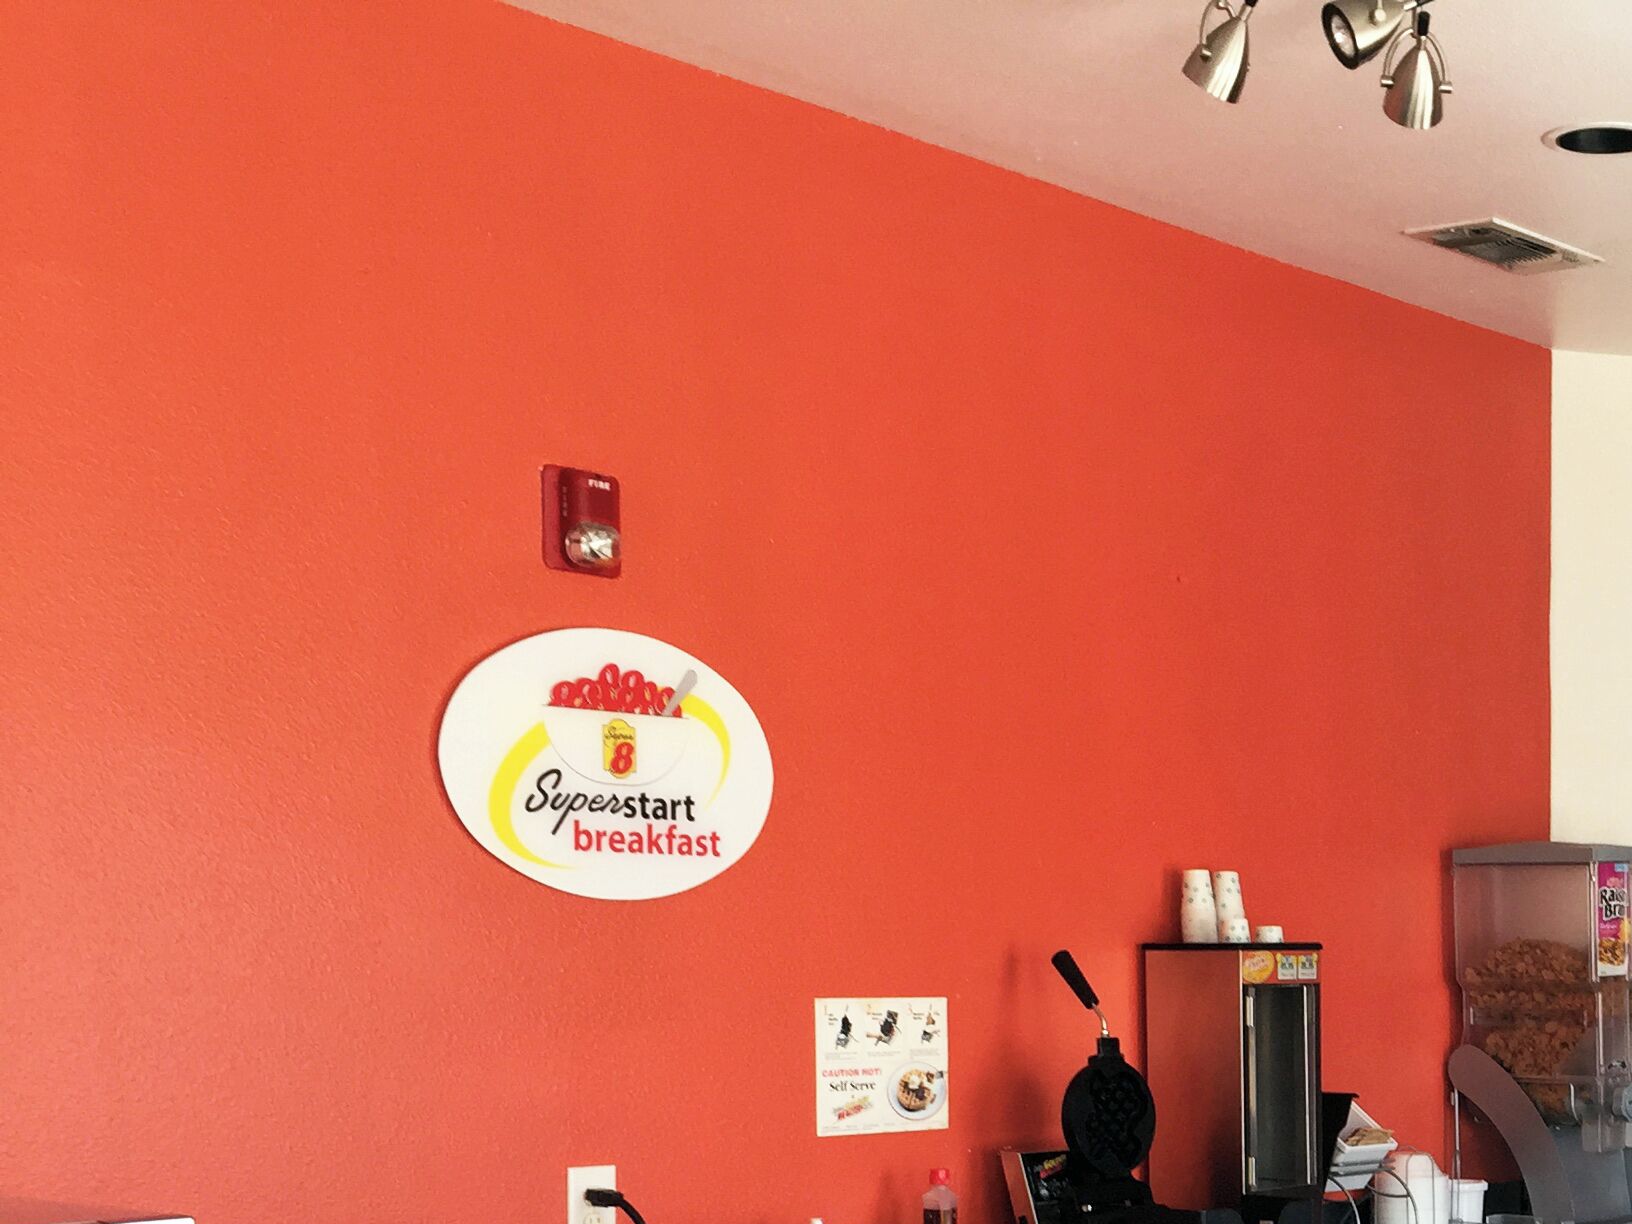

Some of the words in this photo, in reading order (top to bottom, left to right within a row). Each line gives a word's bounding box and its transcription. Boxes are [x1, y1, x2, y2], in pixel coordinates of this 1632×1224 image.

[588, 479, 611, 491] FIRE
[611, 741, 634, 774] 8
[525, 769, 695, 835] Superstart
[573, 820, 721, 857] breakfast
[822, 1069, 859, 1077] CAUTION
[829, 1080, 848, 1092] Self
[850, 1080, 876, 1091] Serve
